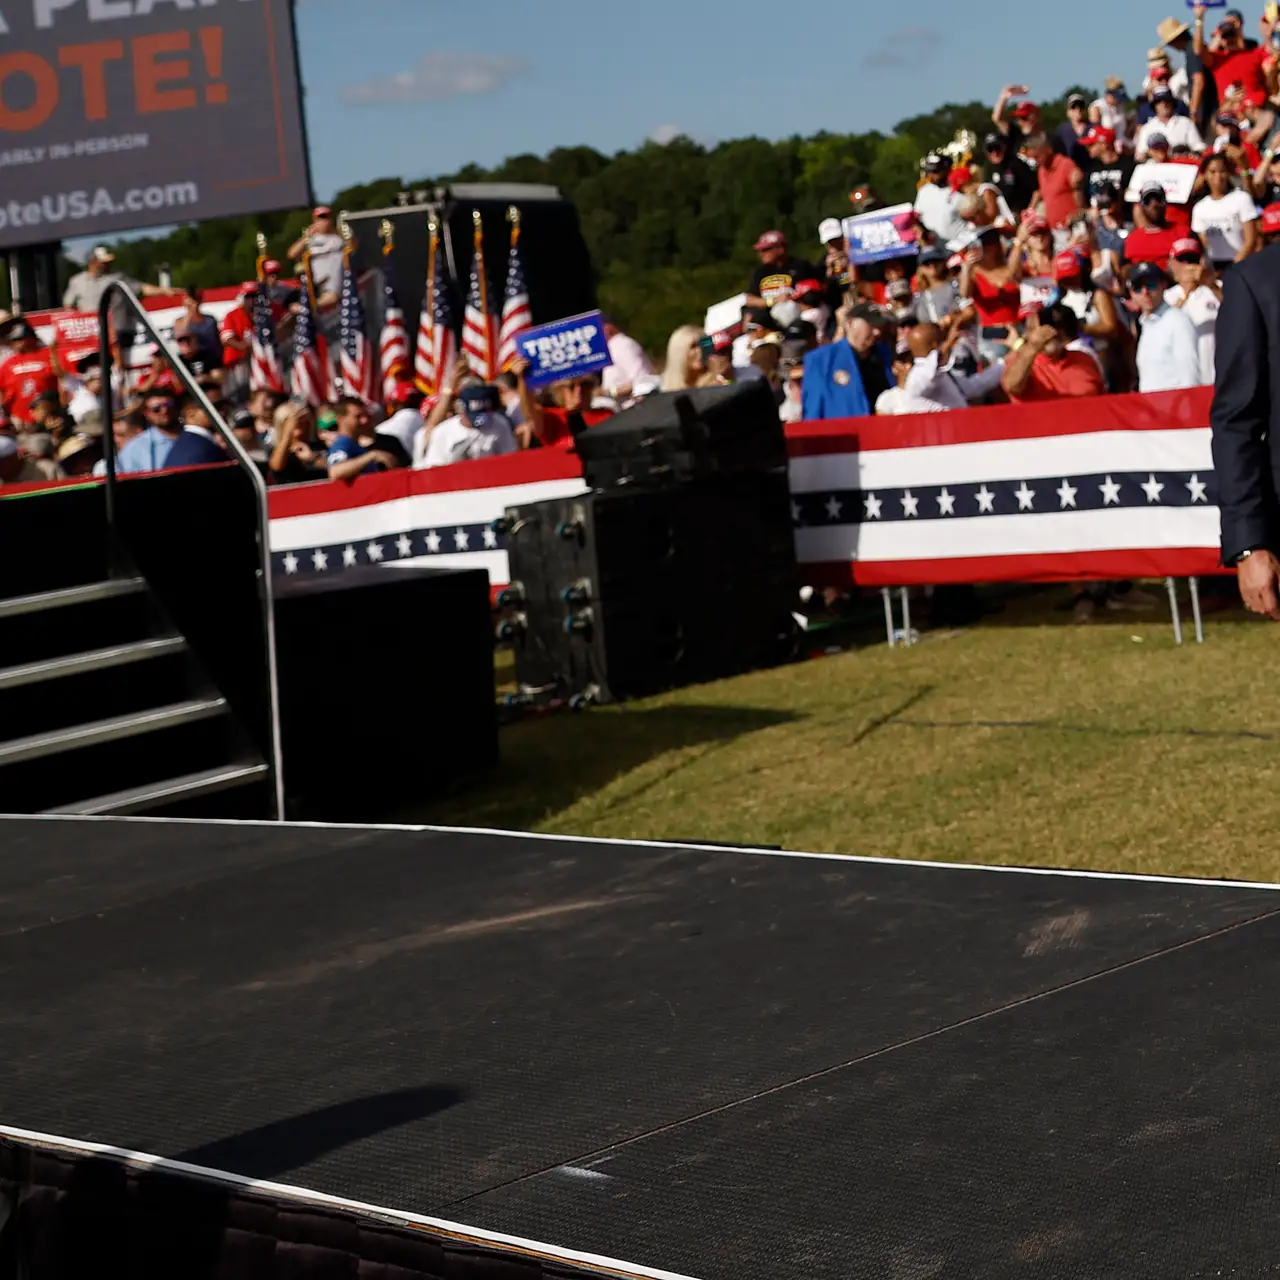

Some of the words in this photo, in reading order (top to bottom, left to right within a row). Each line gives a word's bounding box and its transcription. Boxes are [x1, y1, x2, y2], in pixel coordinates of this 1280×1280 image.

[49, 132, 149, 160] IN-PERSON
[522, 324, 598, 358] TRUMP
[538, 341, 593, 369] 2024
